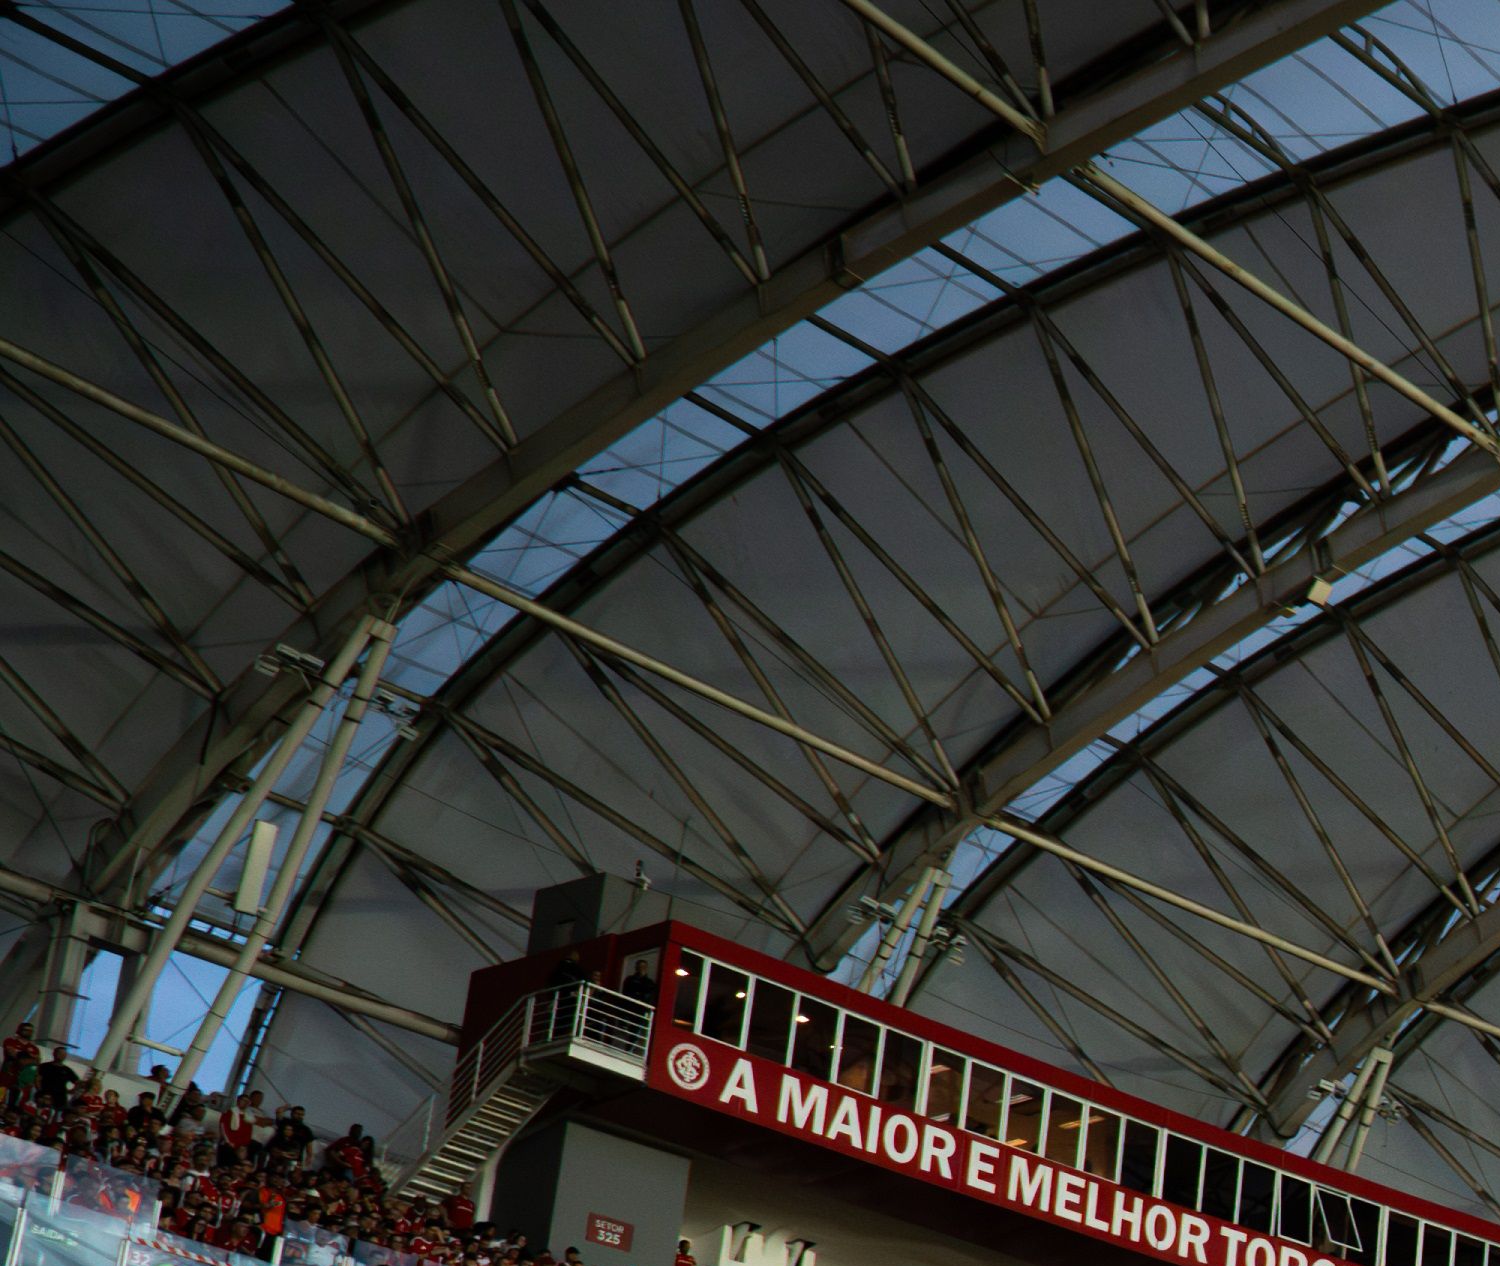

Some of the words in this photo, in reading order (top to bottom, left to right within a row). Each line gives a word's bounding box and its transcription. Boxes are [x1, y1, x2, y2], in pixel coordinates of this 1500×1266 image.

[719, 1058, 760, 1114] A
[776, 1074, 956, 1181] MAIOR
[964, 1140, 998, 1195] E
[1006, 1154, 1211, 1265] MELHOR
[595, 1218, 624, 1234] SETOR
[597, 1229, 621, 1245] 325
